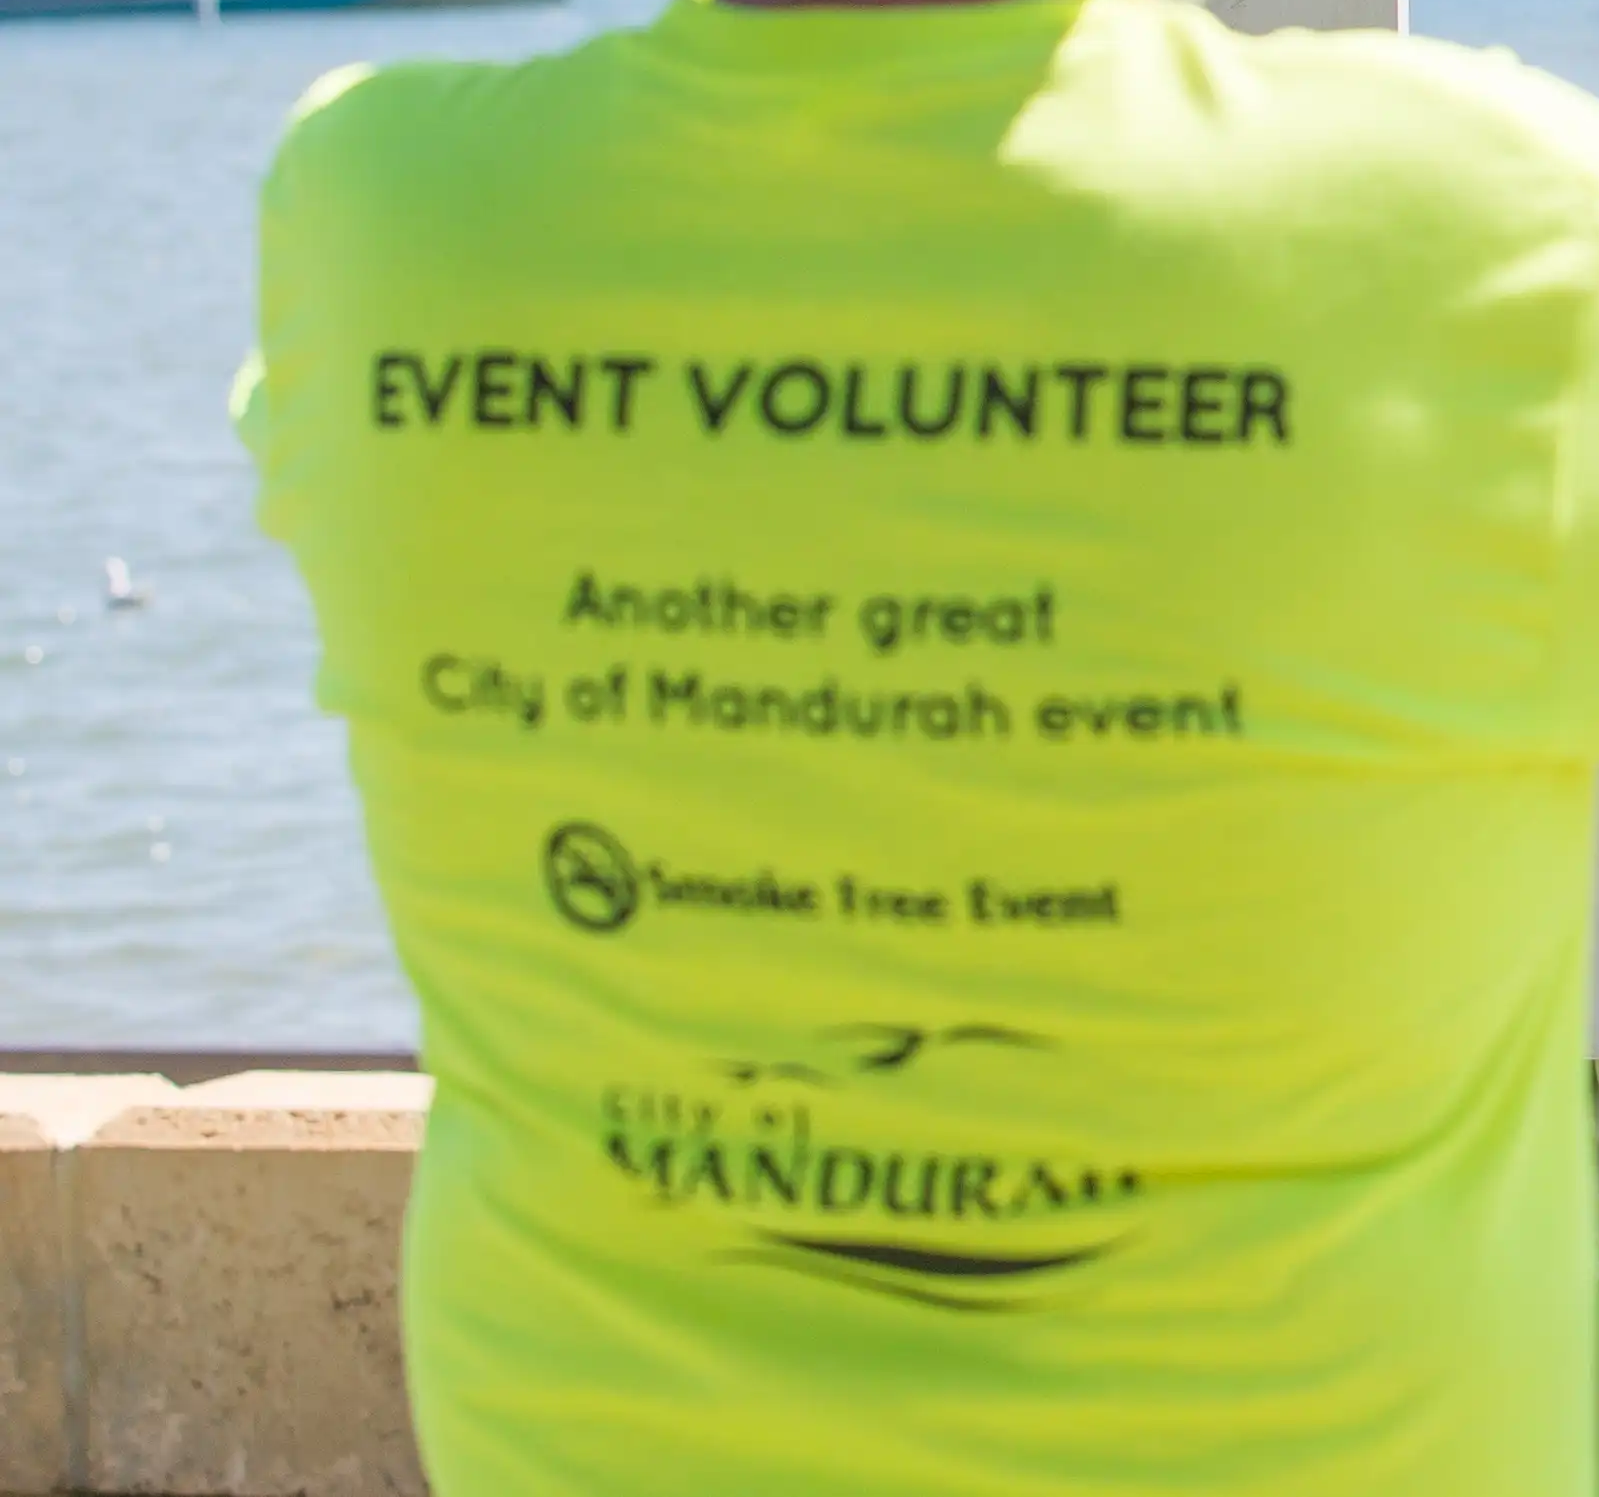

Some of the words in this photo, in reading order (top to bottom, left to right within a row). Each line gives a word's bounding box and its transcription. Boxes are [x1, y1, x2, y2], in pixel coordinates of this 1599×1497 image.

[372, 350, 654, 432] EVENT
[686, 360, 1296, 446] VOLUNTEER
[564, 570, 836, 636] Another
[858, 582, 1058, 650] great
[420, 652, 546, 730] City
[564, 664, 628, 724] of
[646, 665, 1012, 744] Mandurah
[1034, 682, 1244, 742] event
